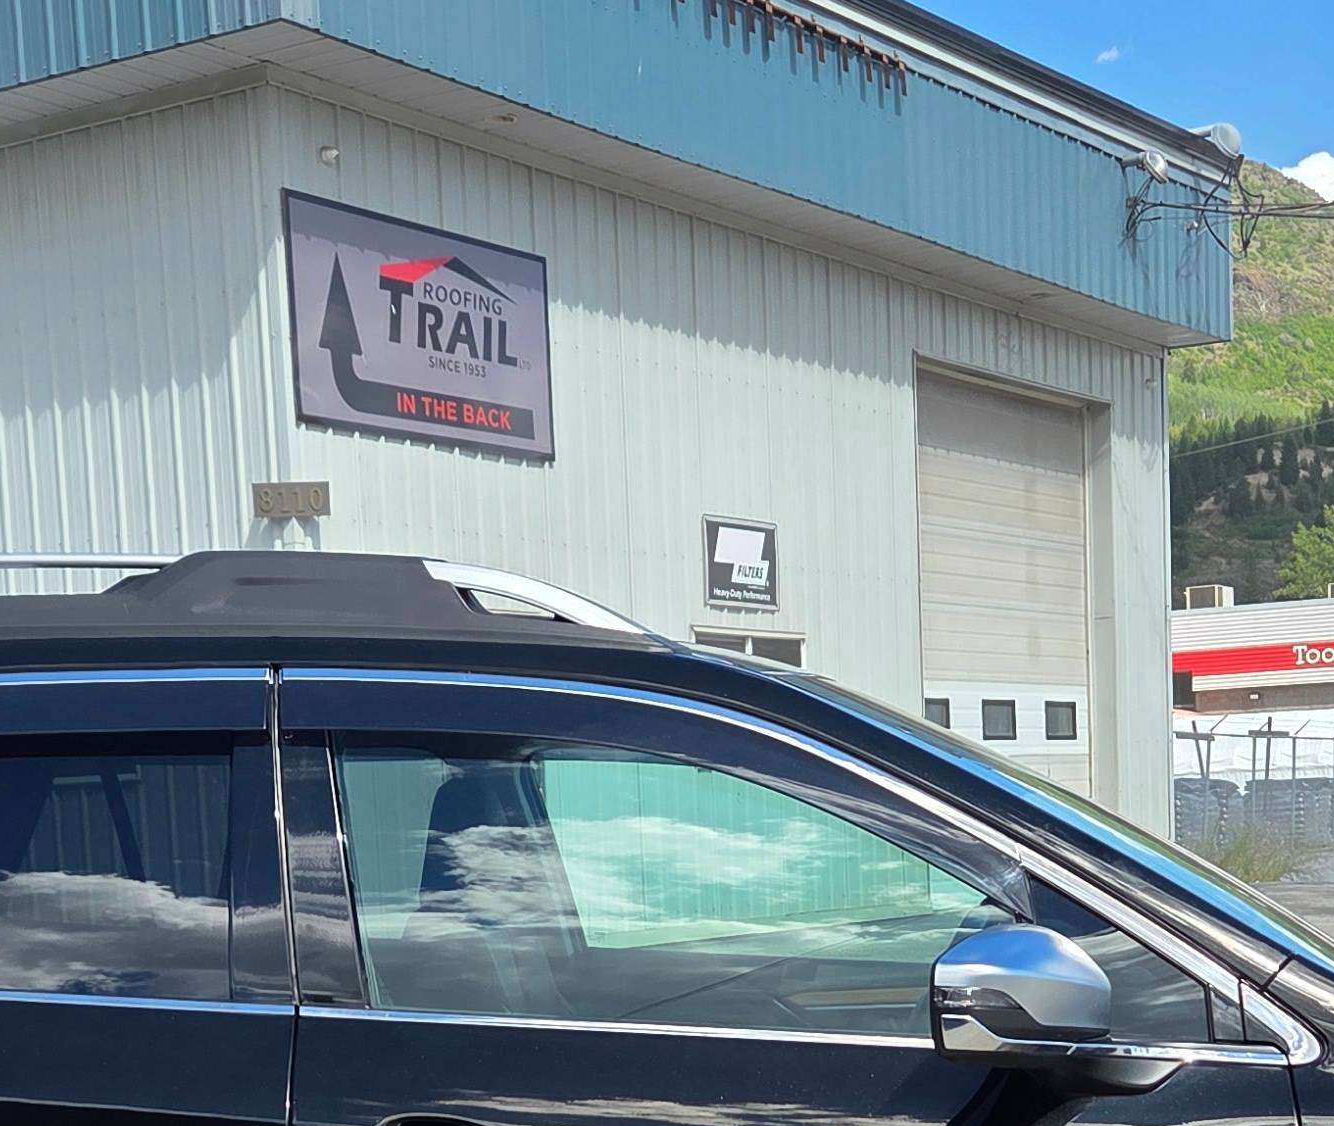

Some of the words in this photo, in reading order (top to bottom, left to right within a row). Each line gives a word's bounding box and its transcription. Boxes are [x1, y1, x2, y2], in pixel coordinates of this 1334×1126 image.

[423, 282, 502, 315] ROOFING
[379, 275, 517, 367] TRAIL
[428, 356, 461, 373] SINCE
[464, 362, 487, 378] 1953
[397, 391, 415, 415] IN
[421, 396, 457, 422] THE
[463, 403, 512, 431] BACK
[737, 564, 763, 579] FILTERS
